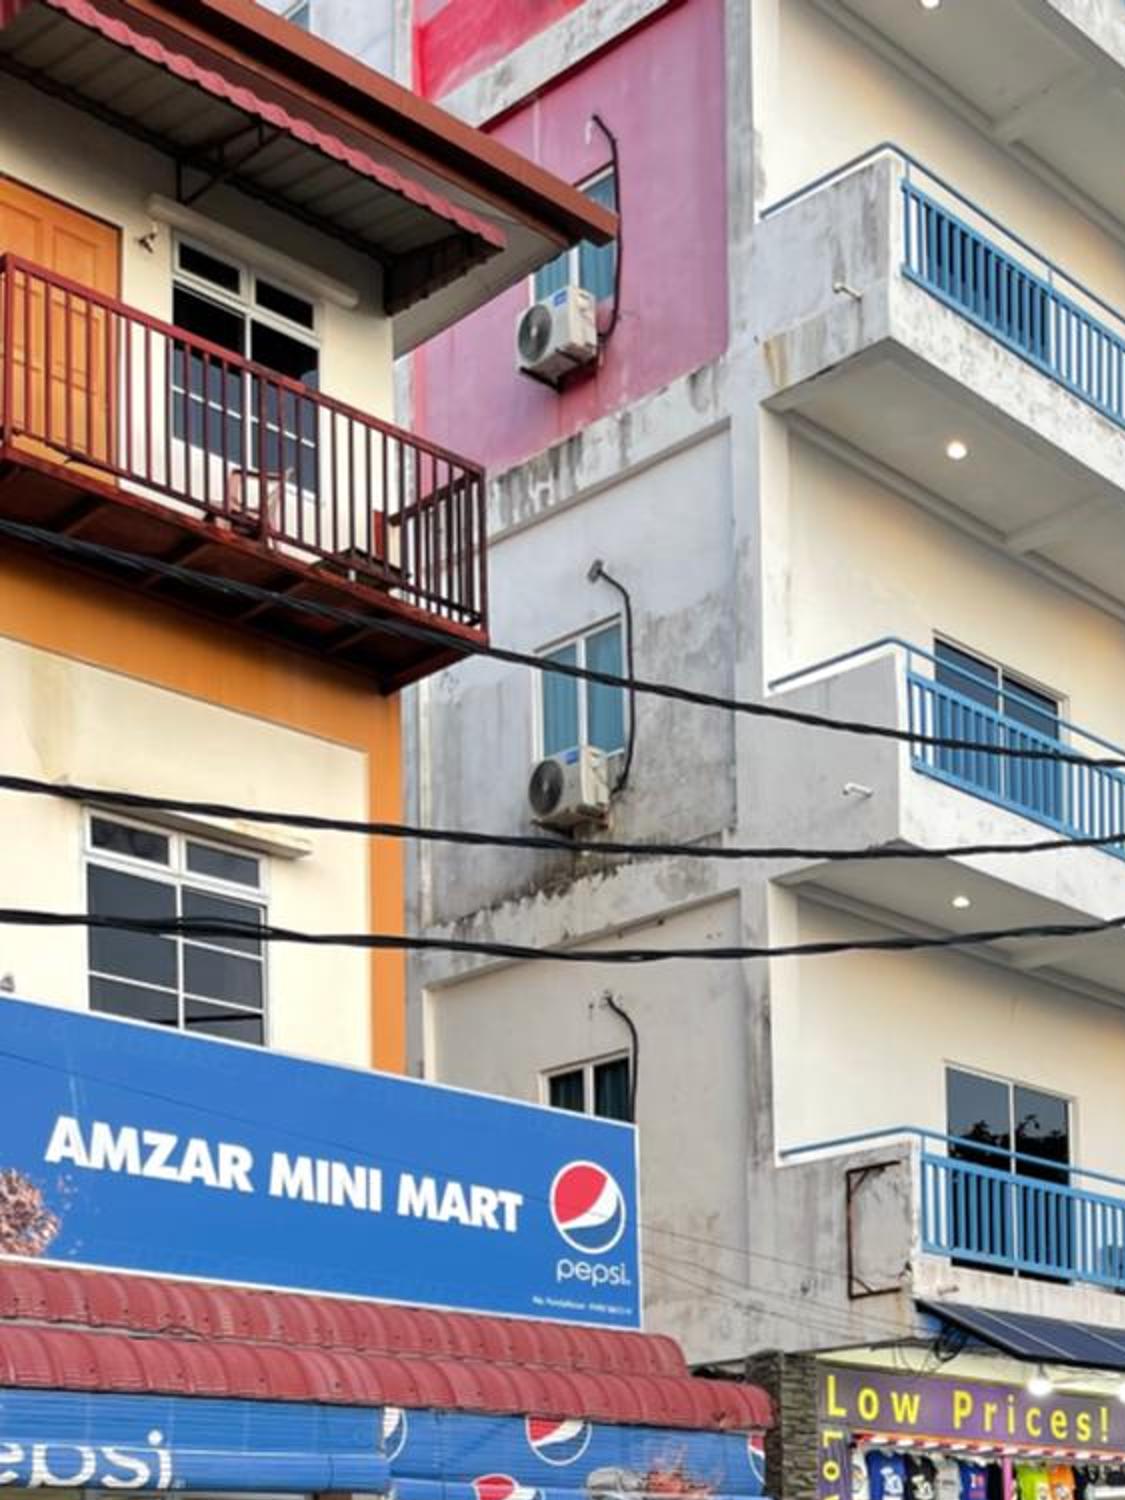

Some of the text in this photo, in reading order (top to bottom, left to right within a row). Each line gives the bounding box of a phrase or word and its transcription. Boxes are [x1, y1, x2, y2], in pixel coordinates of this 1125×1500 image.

[44, 1115, 523, 1233] AMZAR MINI MART
[556, 1257, 627, 1288] pepsi
[827, 1374, 1110, 1443] Low Prices!
